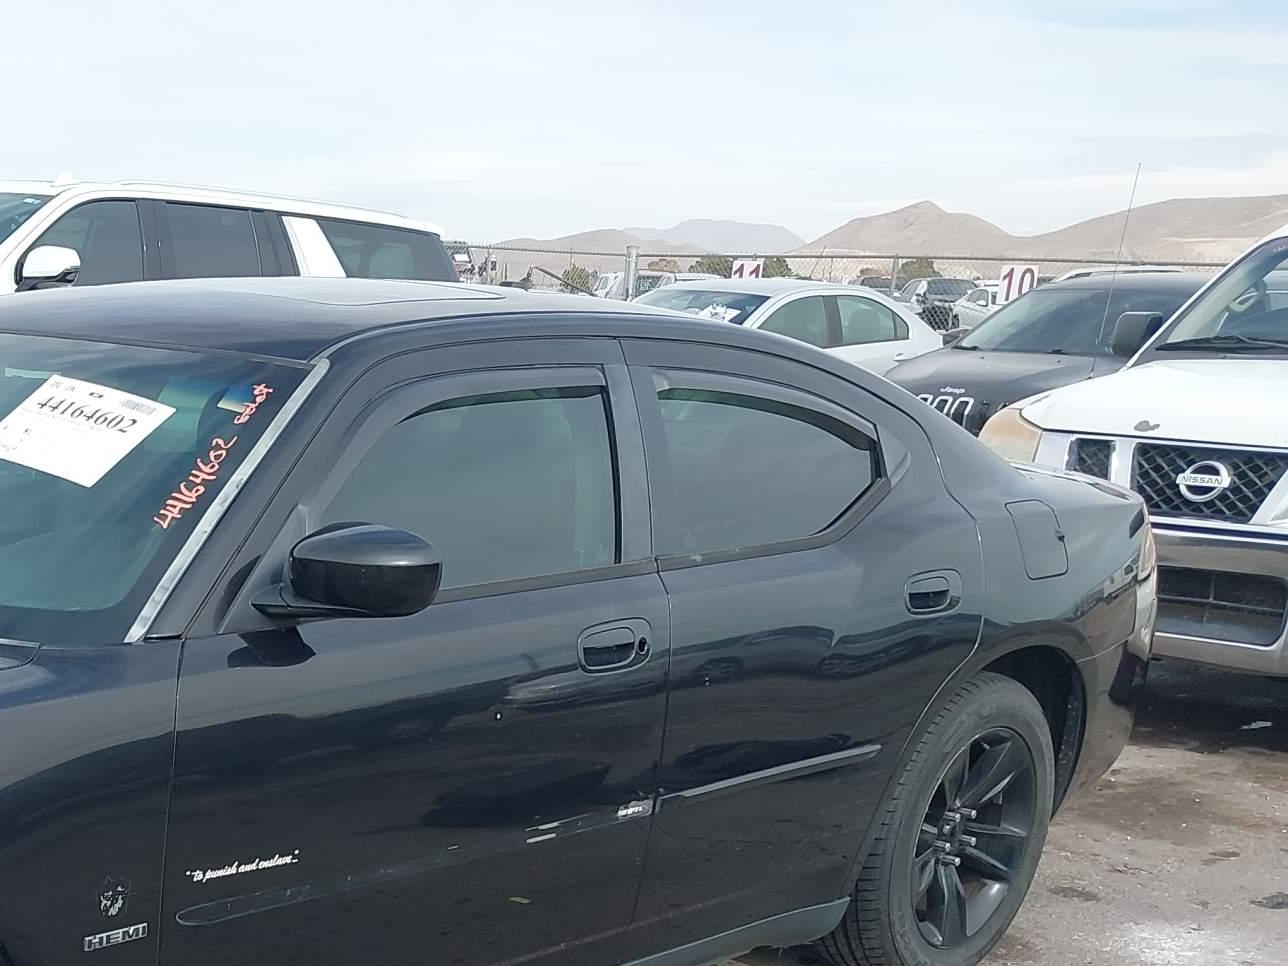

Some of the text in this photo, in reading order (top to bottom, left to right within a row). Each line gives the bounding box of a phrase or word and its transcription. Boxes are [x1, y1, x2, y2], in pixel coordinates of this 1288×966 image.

[1002, 267, 1035, 302] 10
[37, 395, 138, 433] 44164602
[153, 435, 238, 530] 44164602
[1180, 476, 1222, 485] NISSAN
[203, 861, 239, 883] punish
[238, 858, 259, 873] and
[83, 922, 148, 952] HEMI
